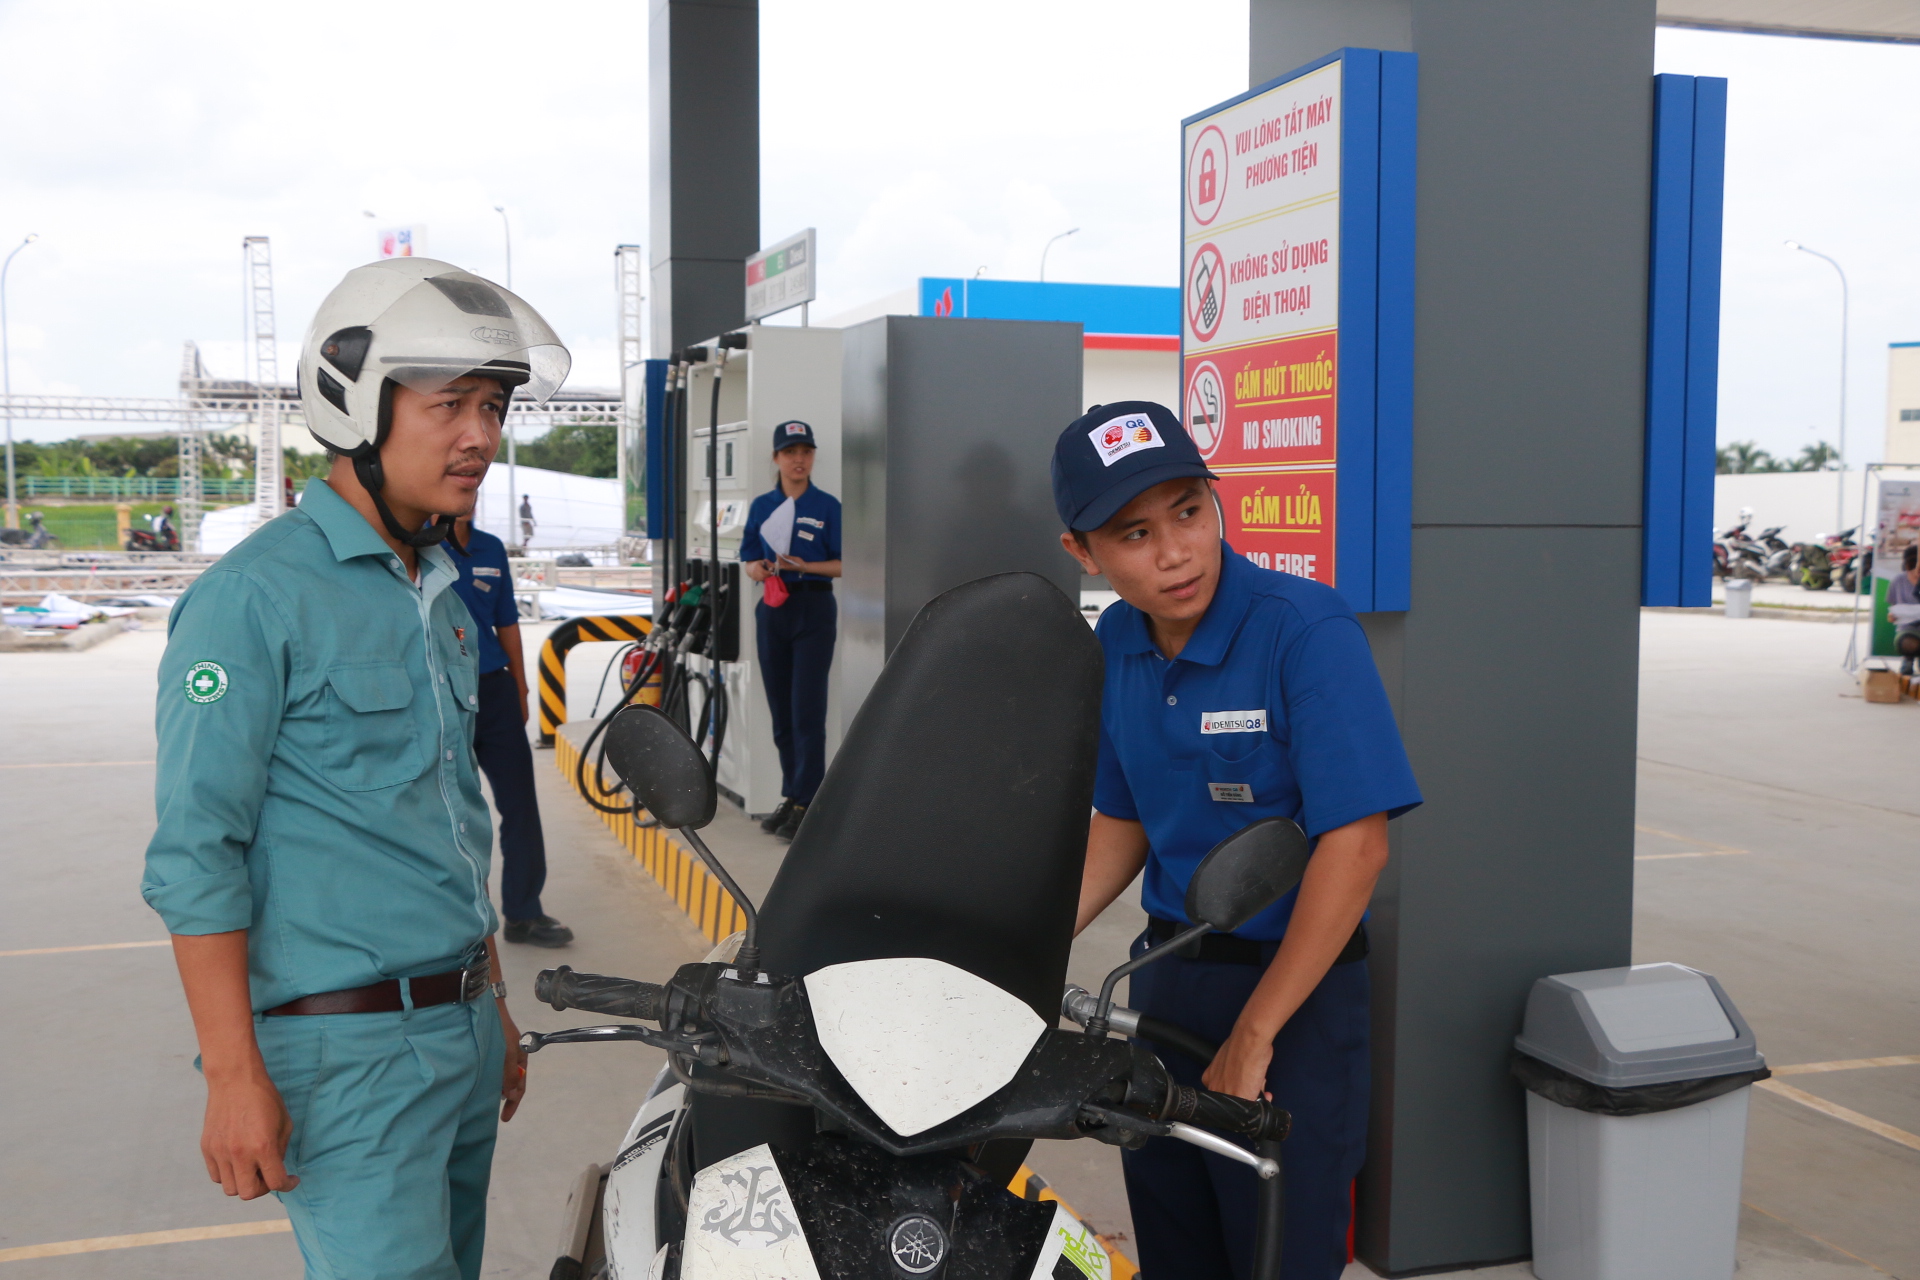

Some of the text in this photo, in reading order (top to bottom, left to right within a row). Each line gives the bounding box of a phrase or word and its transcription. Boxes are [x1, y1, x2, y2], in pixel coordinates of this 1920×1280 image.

[1235, 95, 1333, 156] VUI LÒNG TẮT MÁY
[1246, 140, 1318, 189] PHƯƠNG TIỆN
[1230, 239, 1328, 285] KHÔNG SỬ DỤNG
[1243, 285, 1311, 324] ĐIỆN THOẠI
[1235, 350, 1333, 400] CẤM HÚT THUỐC
[1125, 419, 1146, 429] Q8
[1243, 415, 1322, 450] NO SMOKING
[1241, 484, 1322, 525] CẤM LỬA
[1275, 553, 1316, 581] FIRE
[191, 663, 222, 674] THINK
[1245, 718, 1261, 729] Q8
[613, 1147, 652, 1171] LIMITED
[624, 1135, 664, 1159] EDITION
